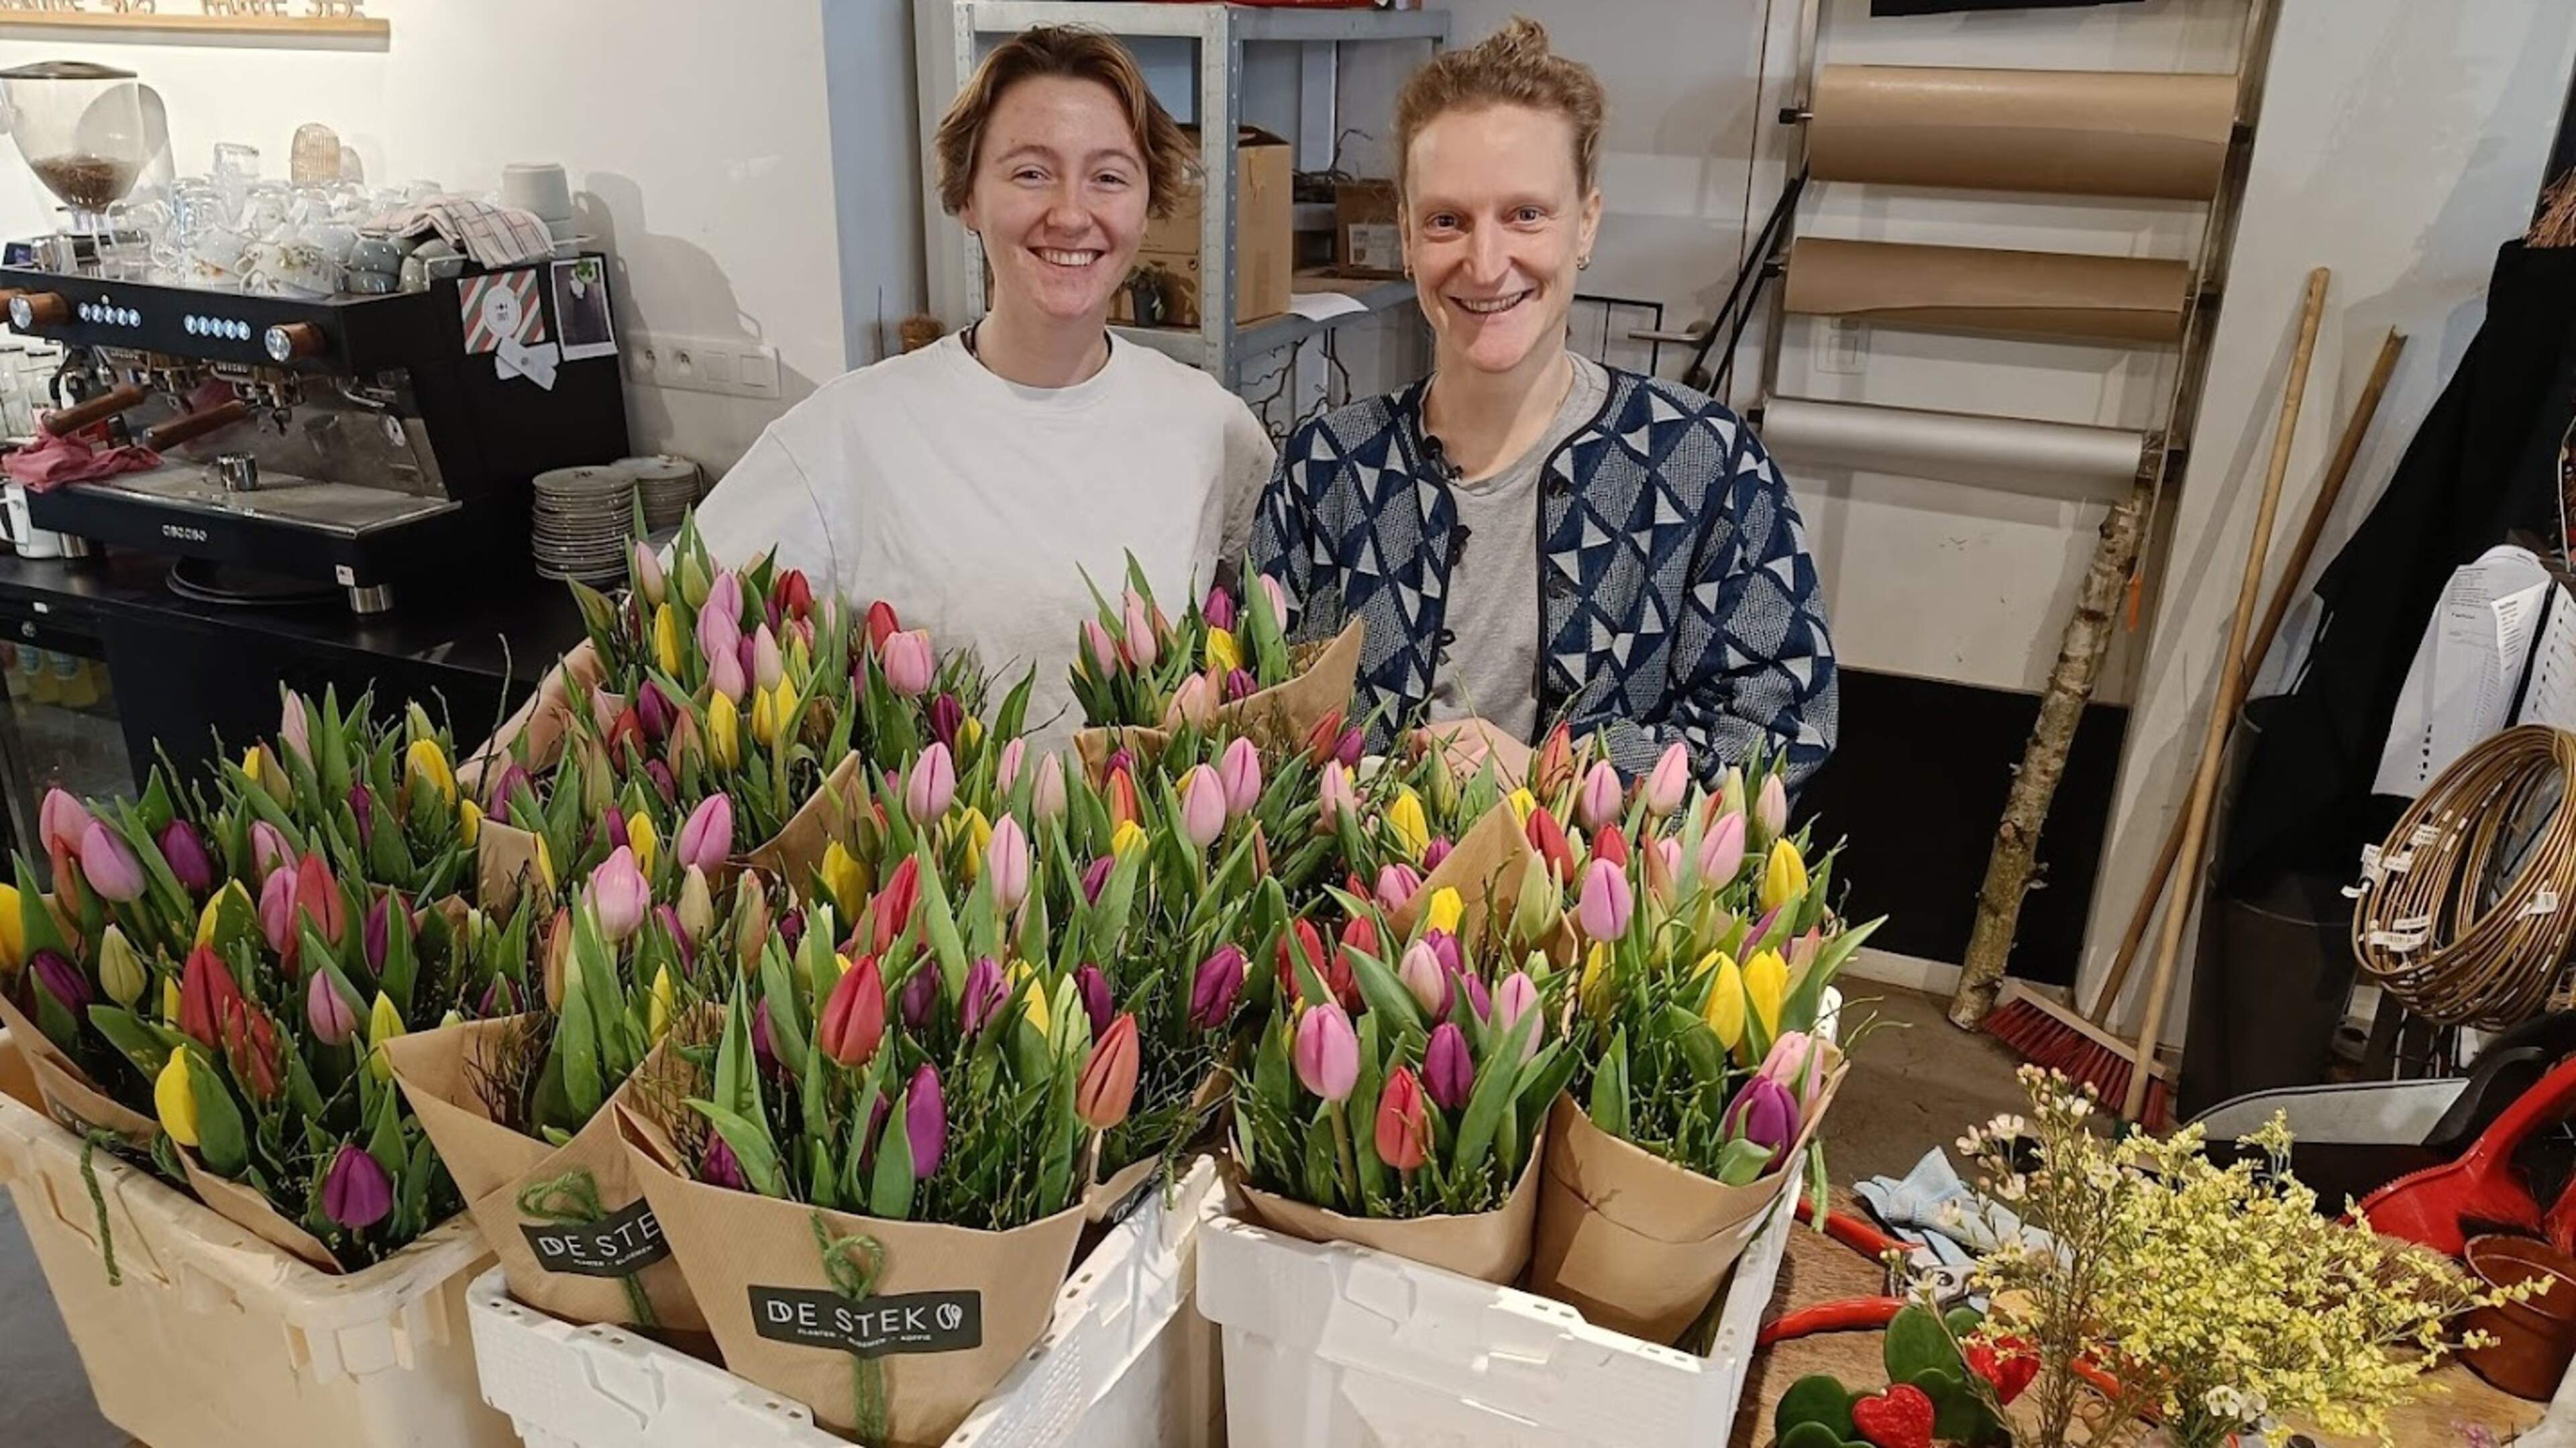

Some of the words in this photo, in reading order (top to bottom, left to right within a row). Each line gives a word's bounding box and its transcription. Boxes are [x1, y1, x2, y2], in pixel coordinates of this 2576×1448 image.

[537, 1235, 586, 1257] DE
[595, 1212, 661, 1257] STE
[767, 1300, 818, 1327] DE
[835, 1306, 926, 1337] STEK
[797, 1328, 836, 1337] PLANTEN
